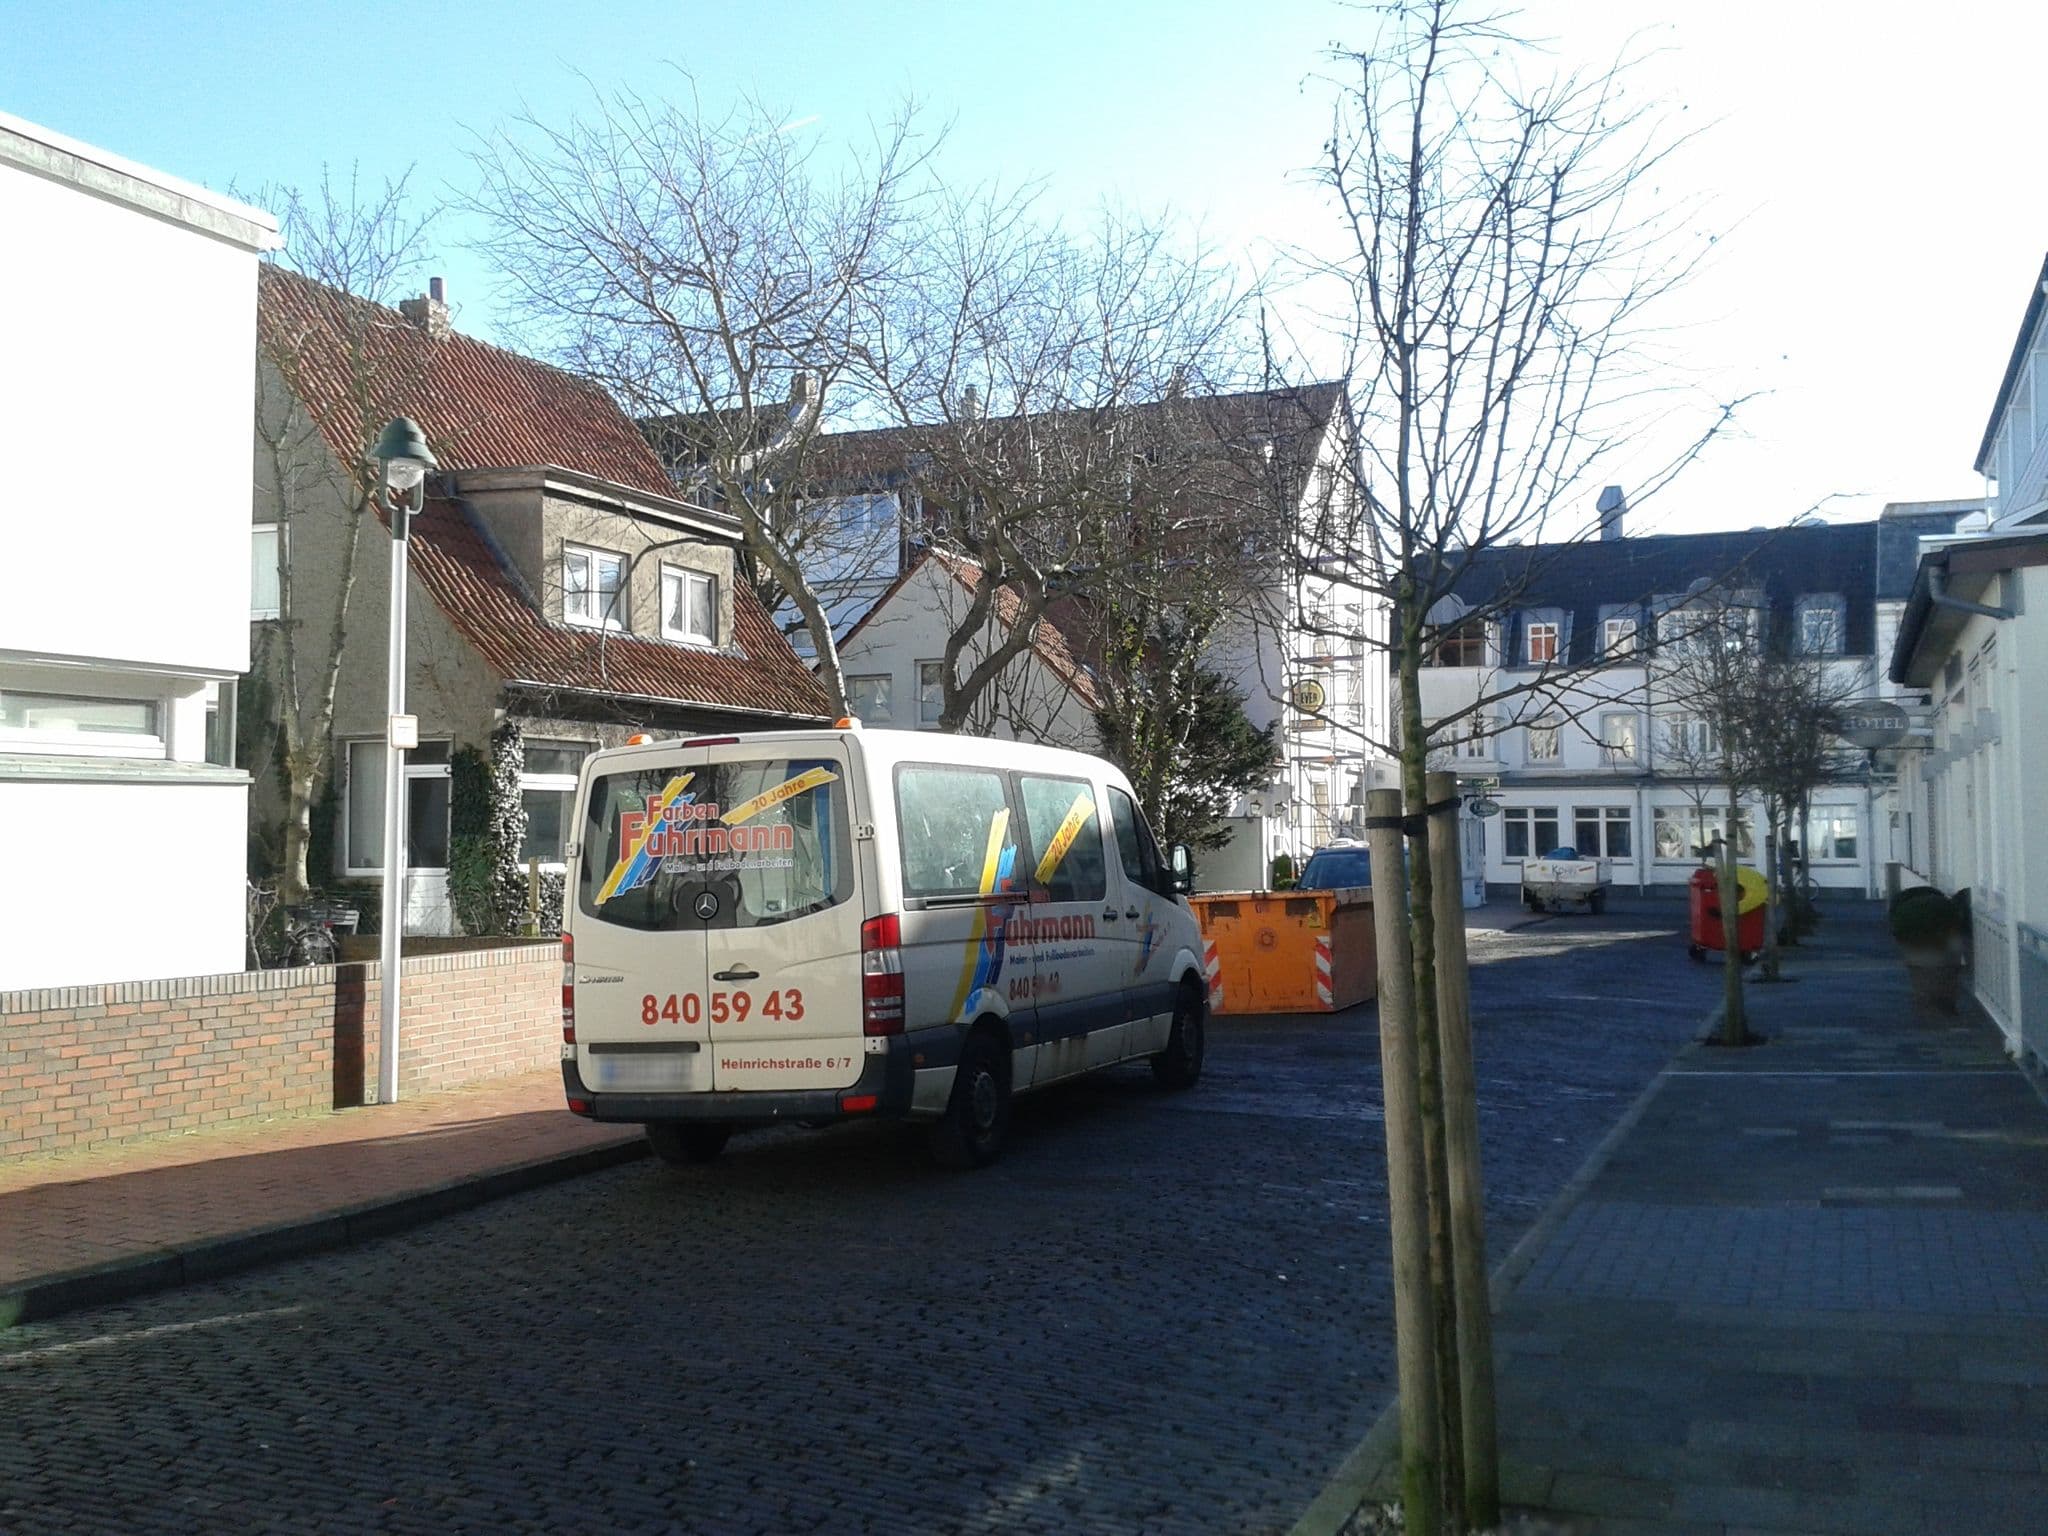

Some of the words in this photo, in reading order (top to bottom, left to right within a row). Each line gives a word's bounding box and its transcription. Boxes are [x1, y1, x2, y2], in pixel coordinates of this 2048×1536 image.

[1846, 716, 1904, 729] HOTEL
[647, 794, 720, 825] Farben
[751, 797, 768, 813] 20
[771, 778, 805, 804] Jahre
[620, 812, 794, 863] Fuhrmann
[982, 895, 1096, 956] Fuhrmann
[1009, 976, 1029, 1000] 840
[642, 993, 701, 1025] 840
[712, 991, 752, 1023] 59
[762, 989, 805, 1022] 43
[721, 1057, 821, 1070] Heinrichstraße
